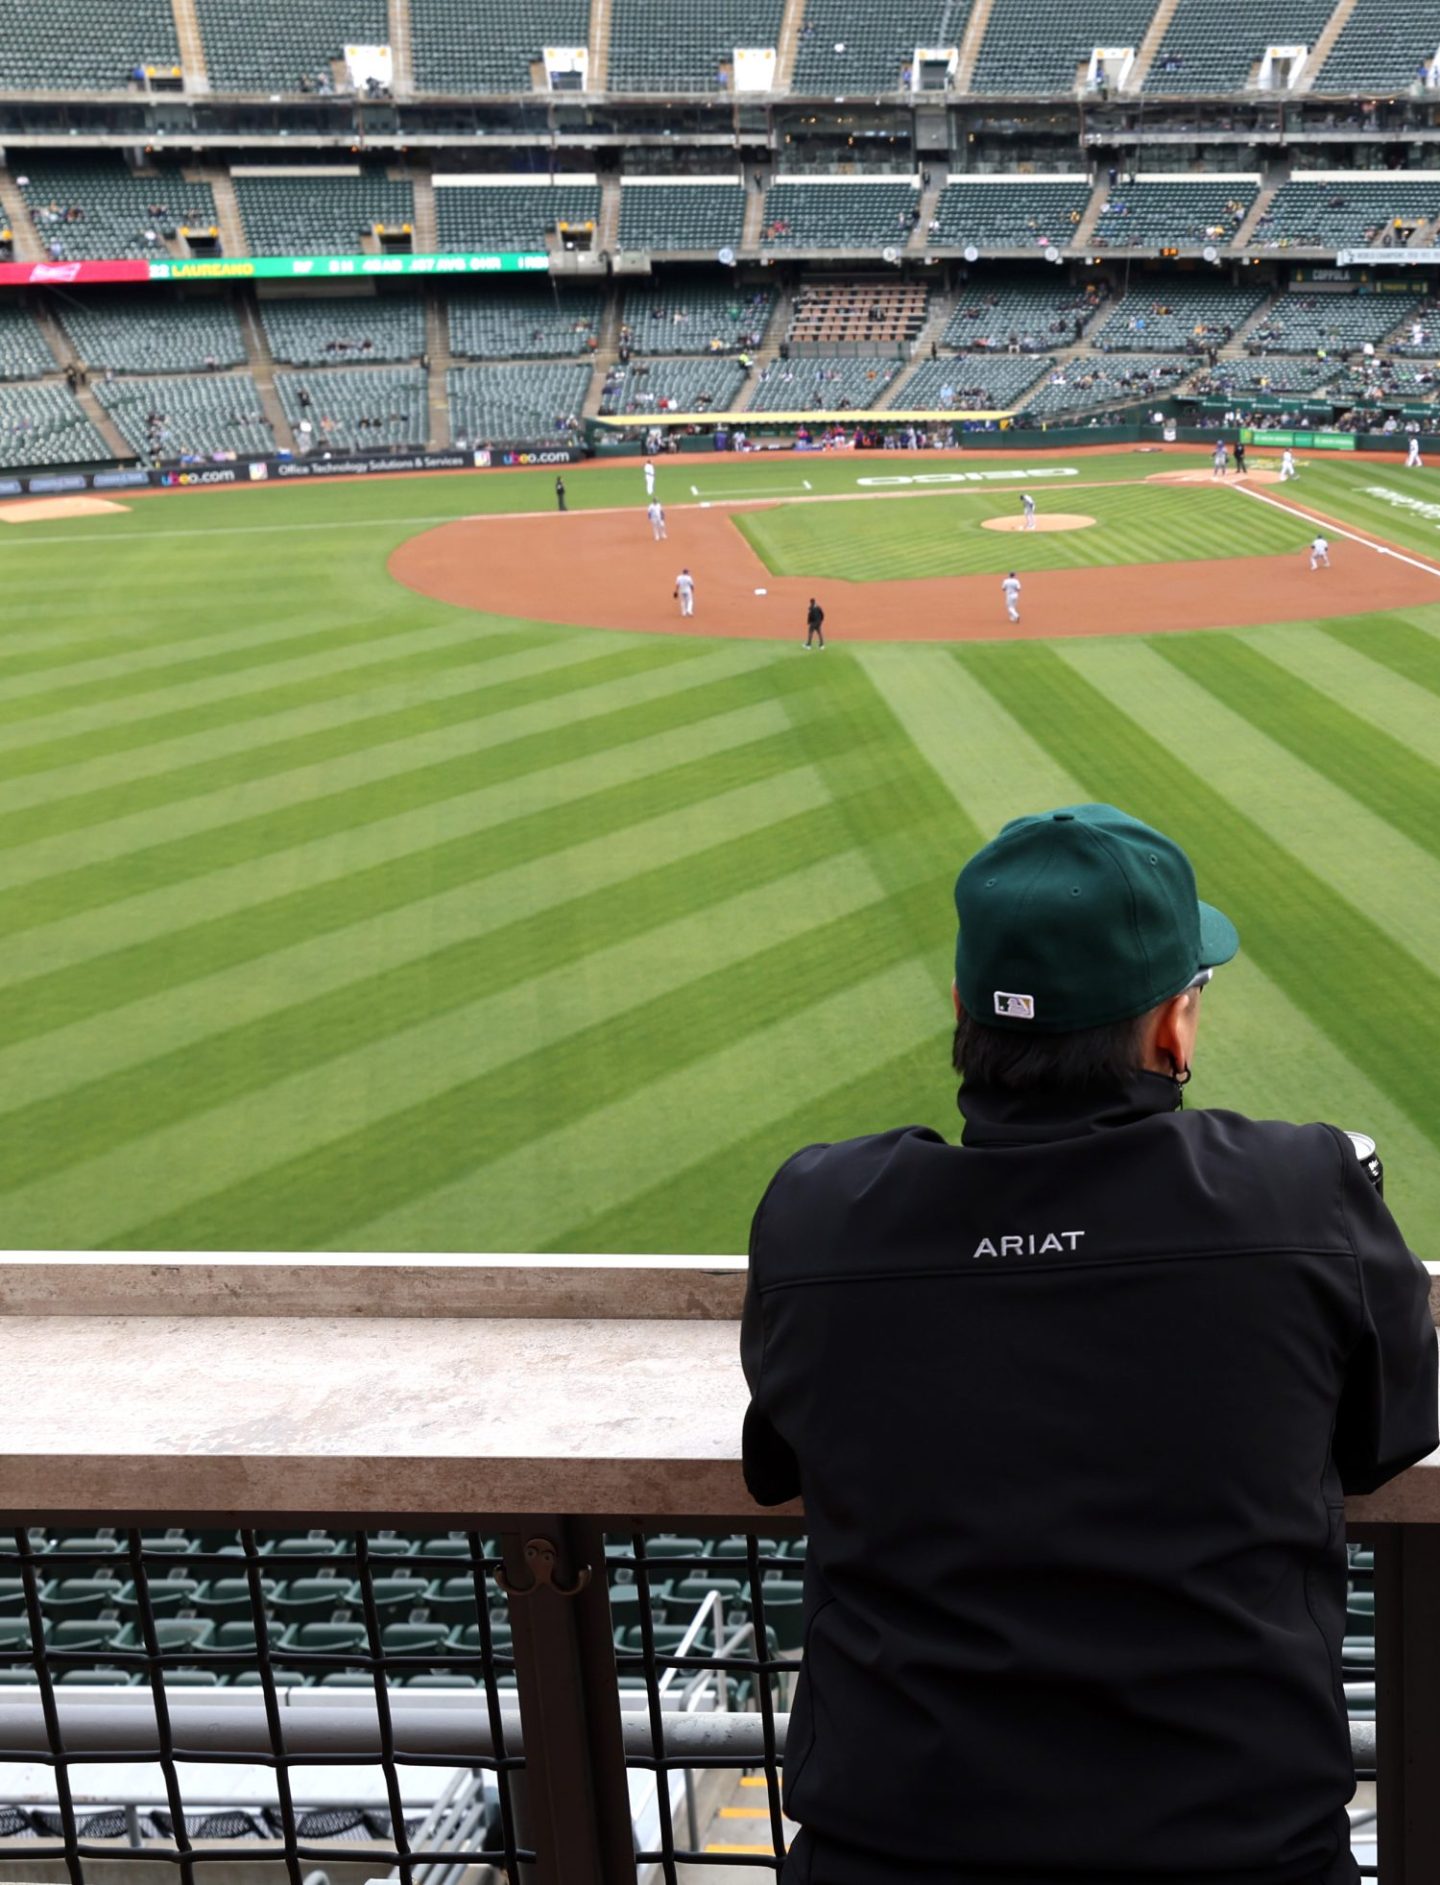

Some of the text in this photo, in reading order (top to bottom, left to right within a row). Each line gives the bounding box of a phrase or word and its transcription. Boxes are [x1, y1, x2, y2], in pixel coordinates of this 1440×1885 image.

[172, 263, 254, 278] LAUREANO
[278, 455, 464, 476] Office Technology Solutions & Services
[503, 451, 570, 466] ubeo.com
[161, 469, 235, 486] ubeo.com
[856, 467, 1080, 486] GEICO
[973, 1230, 1086, 1259] ARIAT
